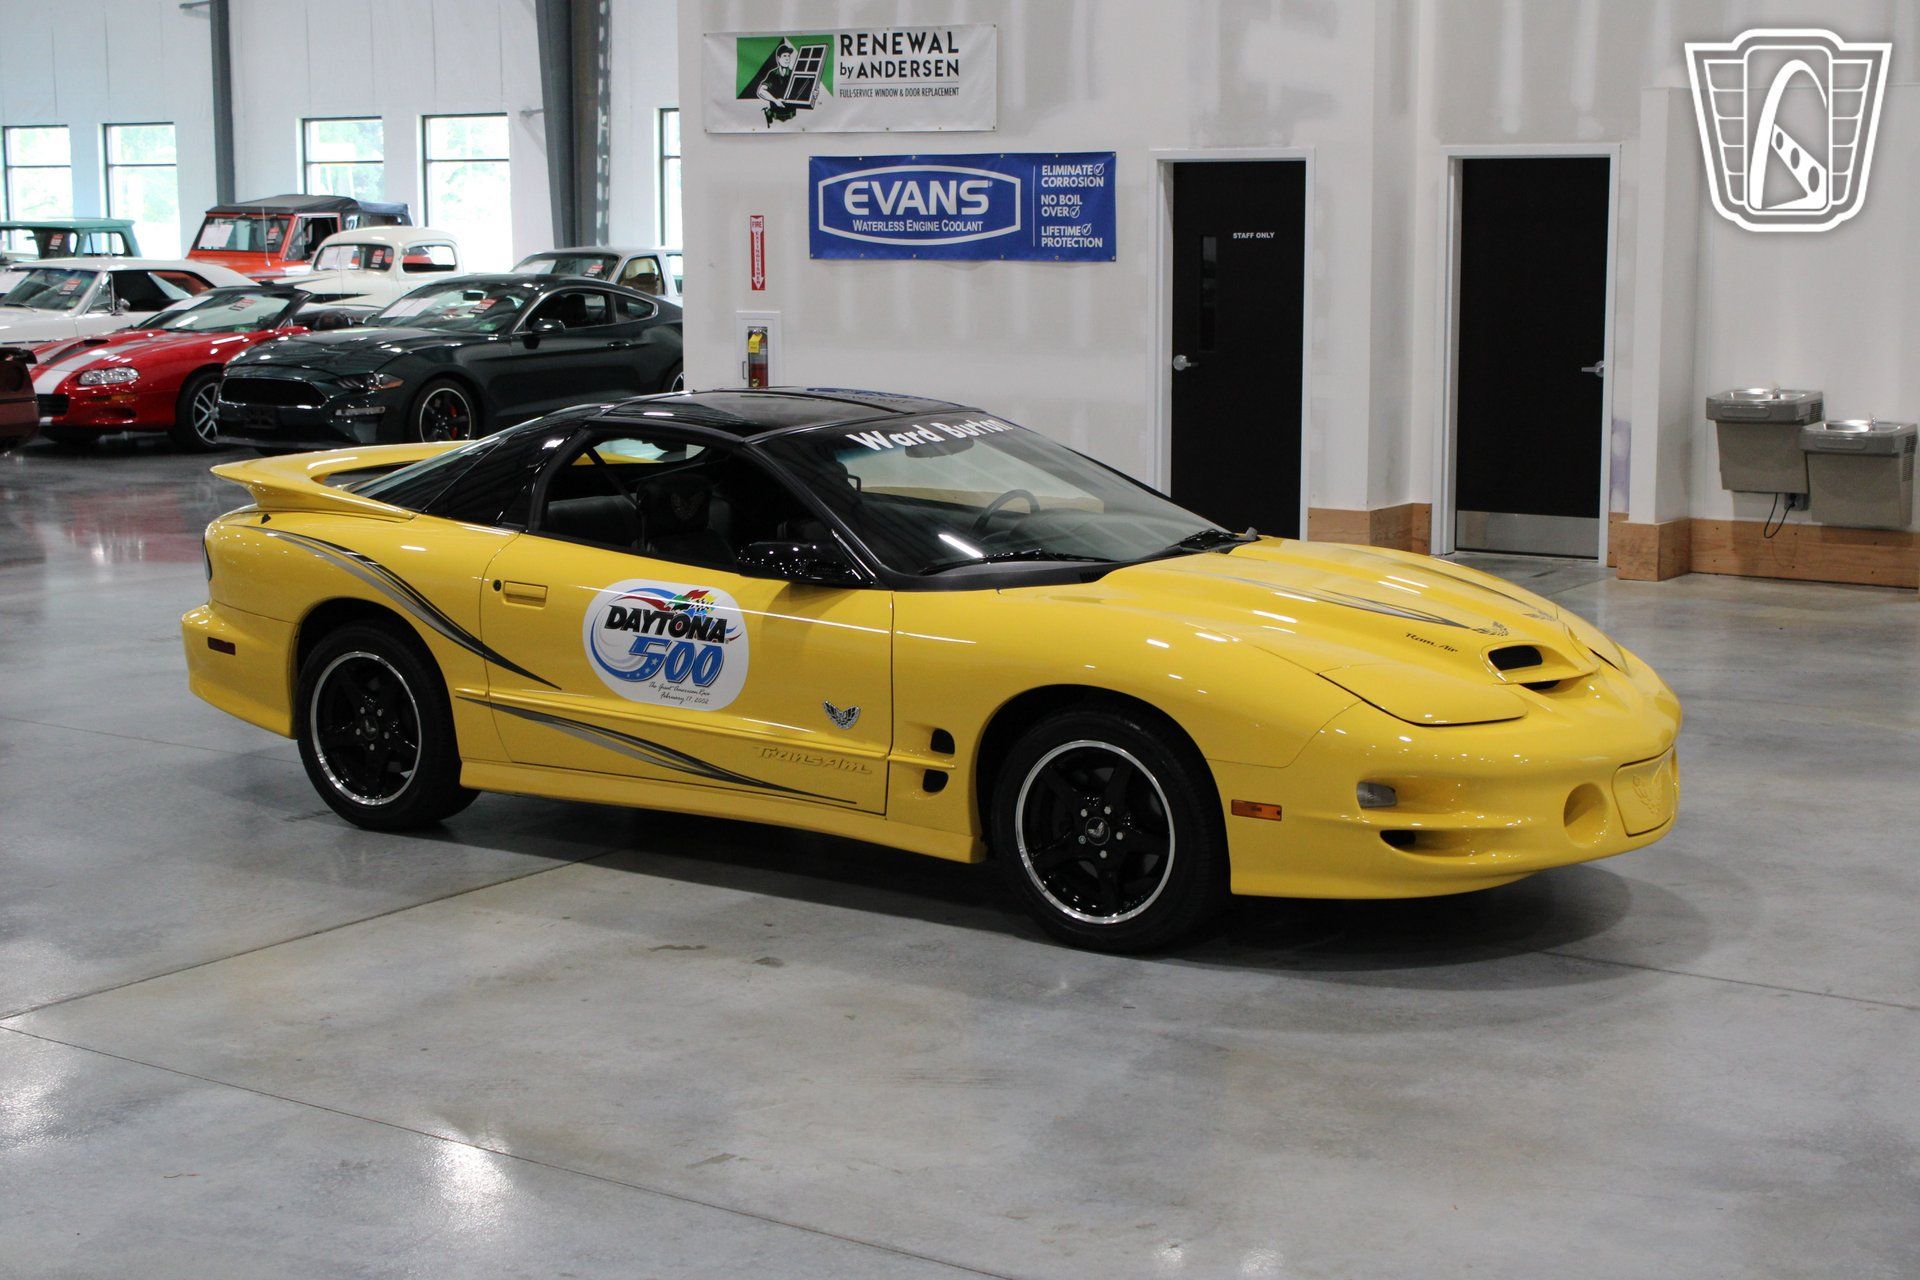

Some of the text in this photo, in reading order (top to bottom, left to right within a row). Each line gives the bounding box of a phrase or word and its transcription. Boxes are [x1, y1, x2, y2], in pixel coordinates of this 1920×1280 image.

[840, 31, 959, 56] RENEWAL
[840, 59, 959, 79] by ANDERSEN
[840, 87, 959, 98] FULL-SERVICE WINDOW & DOOR REPLACEMENT
[1042, 165, 1093, 176] ELIMINATE
[1041, 176, 1104, 188] CORROSION
[844, 180, 989, 216] EVANS
[1041, 195, 1083, 206] NO BOIL
[1041, 206, 1069, 217] OVER
[1041, 226, 1081, 236] LIFETIME
[1041, 237, 1103, 248] PROTECTION
[846, 424, 946, 451] Ward
[604, 605, 728, 644] DAYTONA
[1406, 633, 1437, 647] Ram
[628, 635, 724, 687] 500
[660, 691, 684, 704] February
